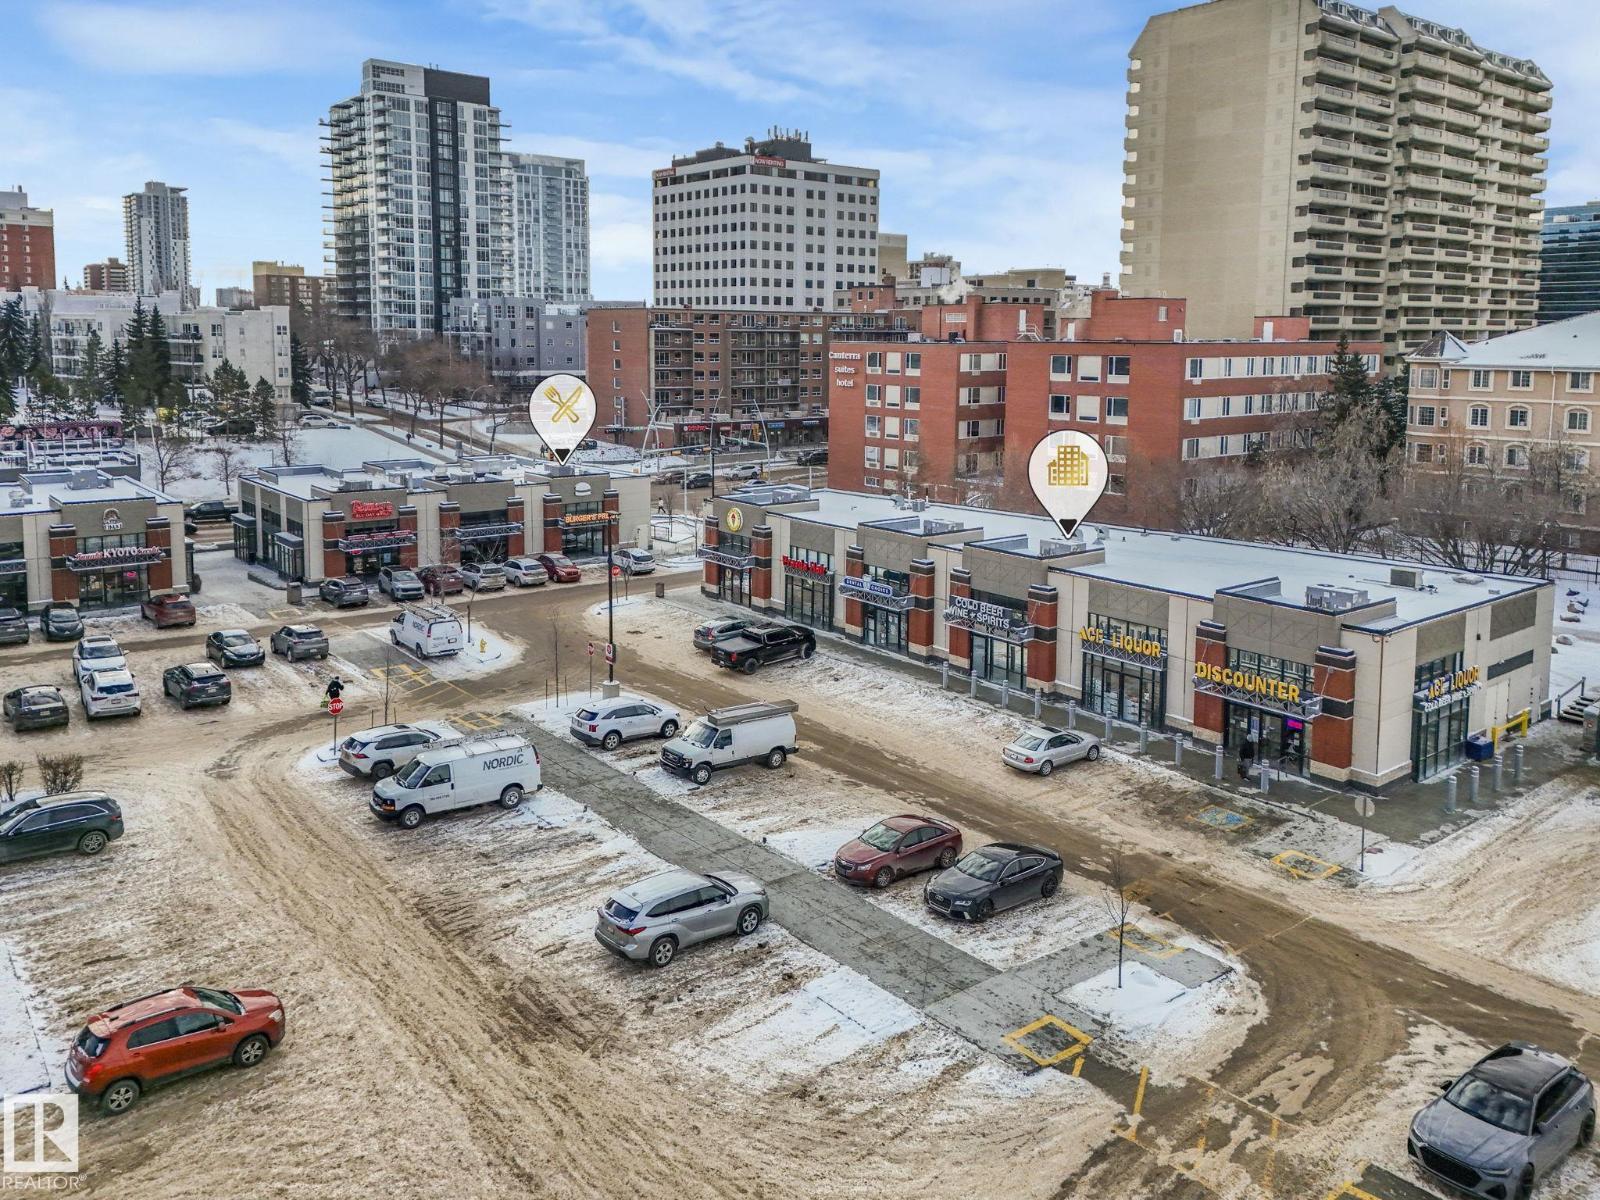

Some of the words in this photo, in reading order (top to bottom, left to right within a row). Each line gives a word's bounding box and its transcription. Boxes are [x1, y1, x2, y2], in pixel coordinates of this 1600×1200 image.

[834, 365, 855, 373] suites
[836, 379, 854, 387] hotel
[565, 512, 597, 524] BURGER'S
[103, 546, 138, 558] KYOTO
[846, 579, 864, 588] DENTAL
[955, 598, 978, 611] COLD
[980, 602, 1003, 617] BEER
[946, 605, 969, 619] WINE
[976, 612, 1010, 629] SPIRITS
[1079, 626, 1104, 644] ACE
[1112, 632, 1161, 657] LIQUOR
[1196, 661, 1300, 704] DISCOUNTER
[1428, 677, 1446, 700] ACE
[1450, 665, 1480, 692] LIQUOR
[328, 702, 344, 711] STOP
[483, 754, 524, 771] NORDIC
